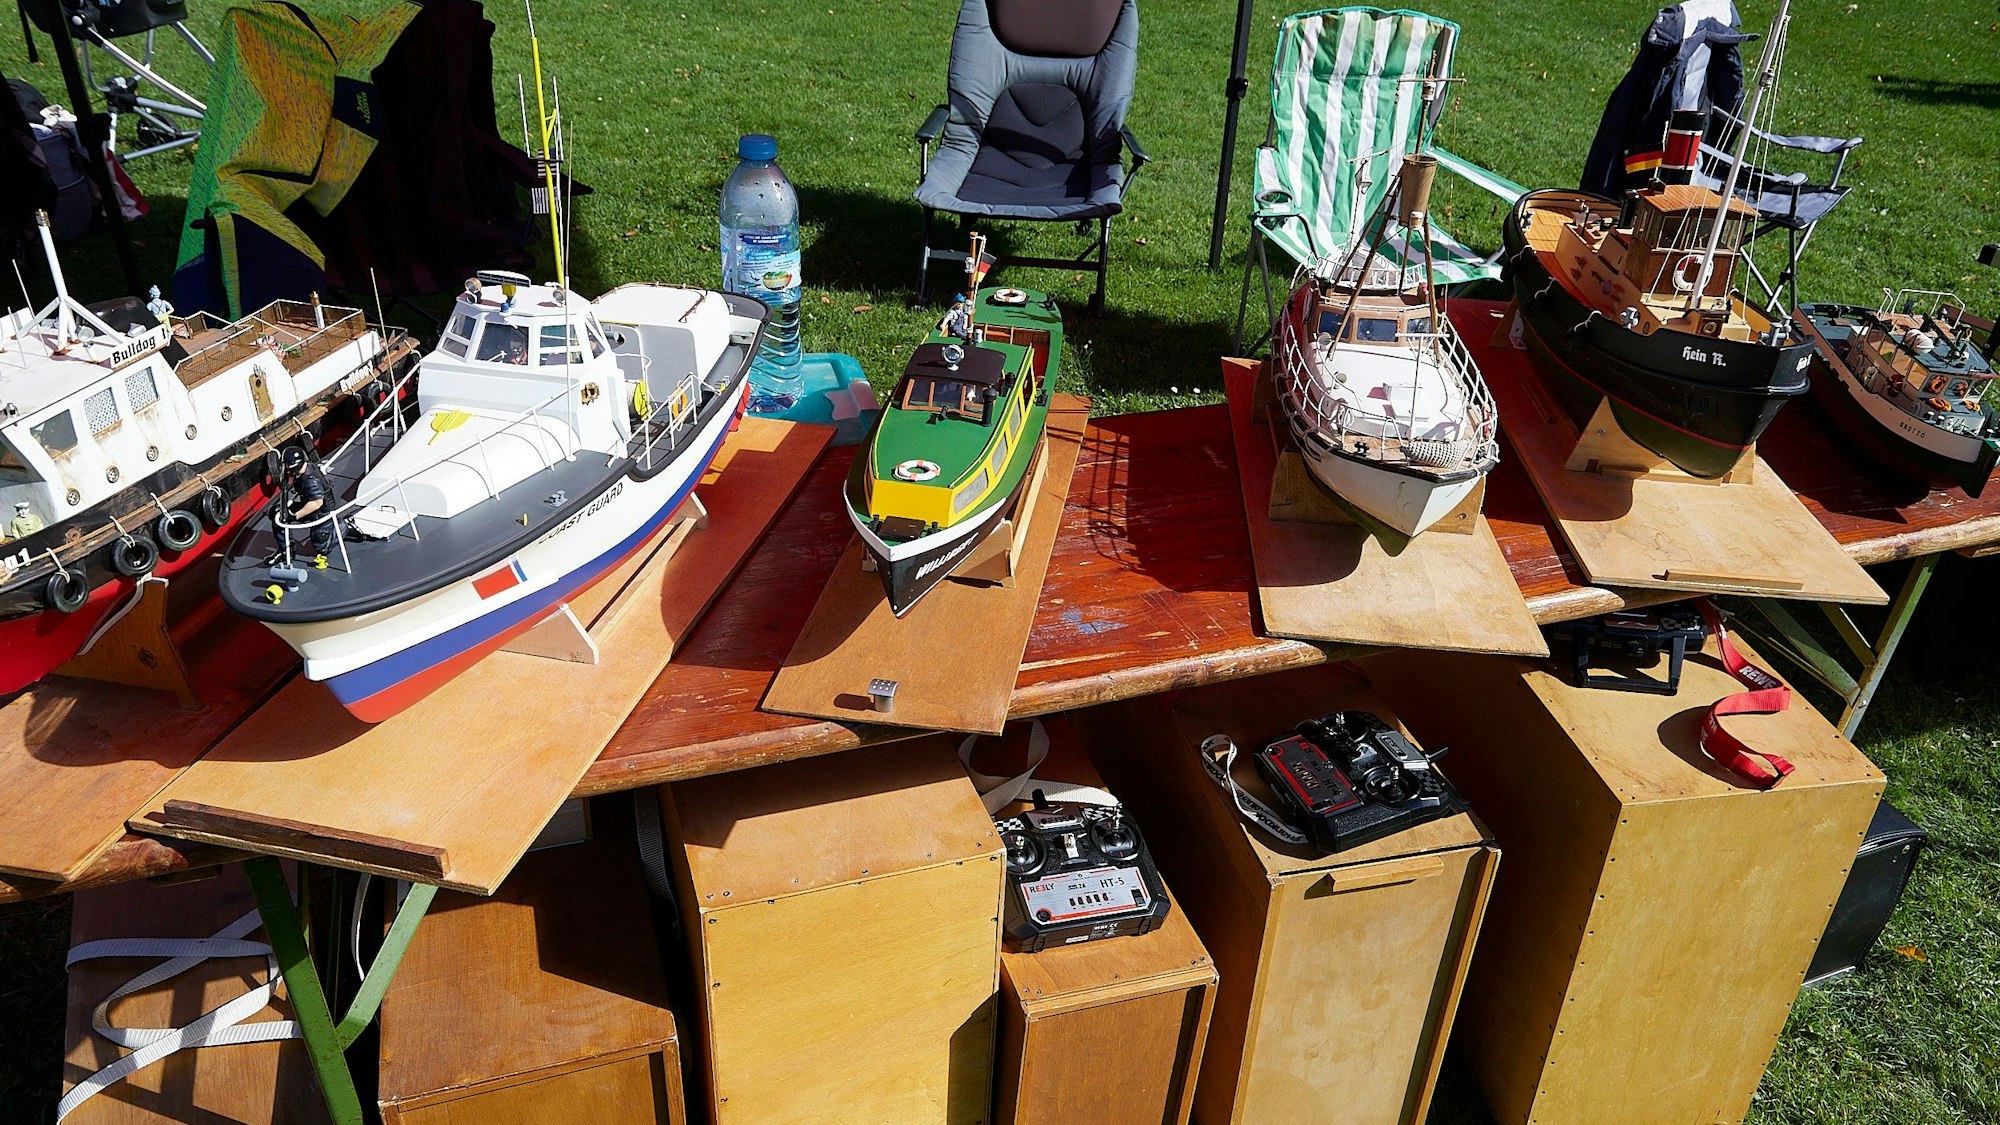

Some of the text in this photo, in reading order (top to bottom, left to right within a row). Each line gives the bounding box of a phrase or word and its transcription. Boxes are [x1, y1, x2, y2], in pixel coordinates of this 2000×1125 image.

[112, 335, 156, 364] Bulldog
[1682, 346, 1707, 363] Hein
[587, 482, 623, 516] GUARD
[1029, 882, 1055, 893] REELY
[1099, 876, 1125, 888] HT-5
